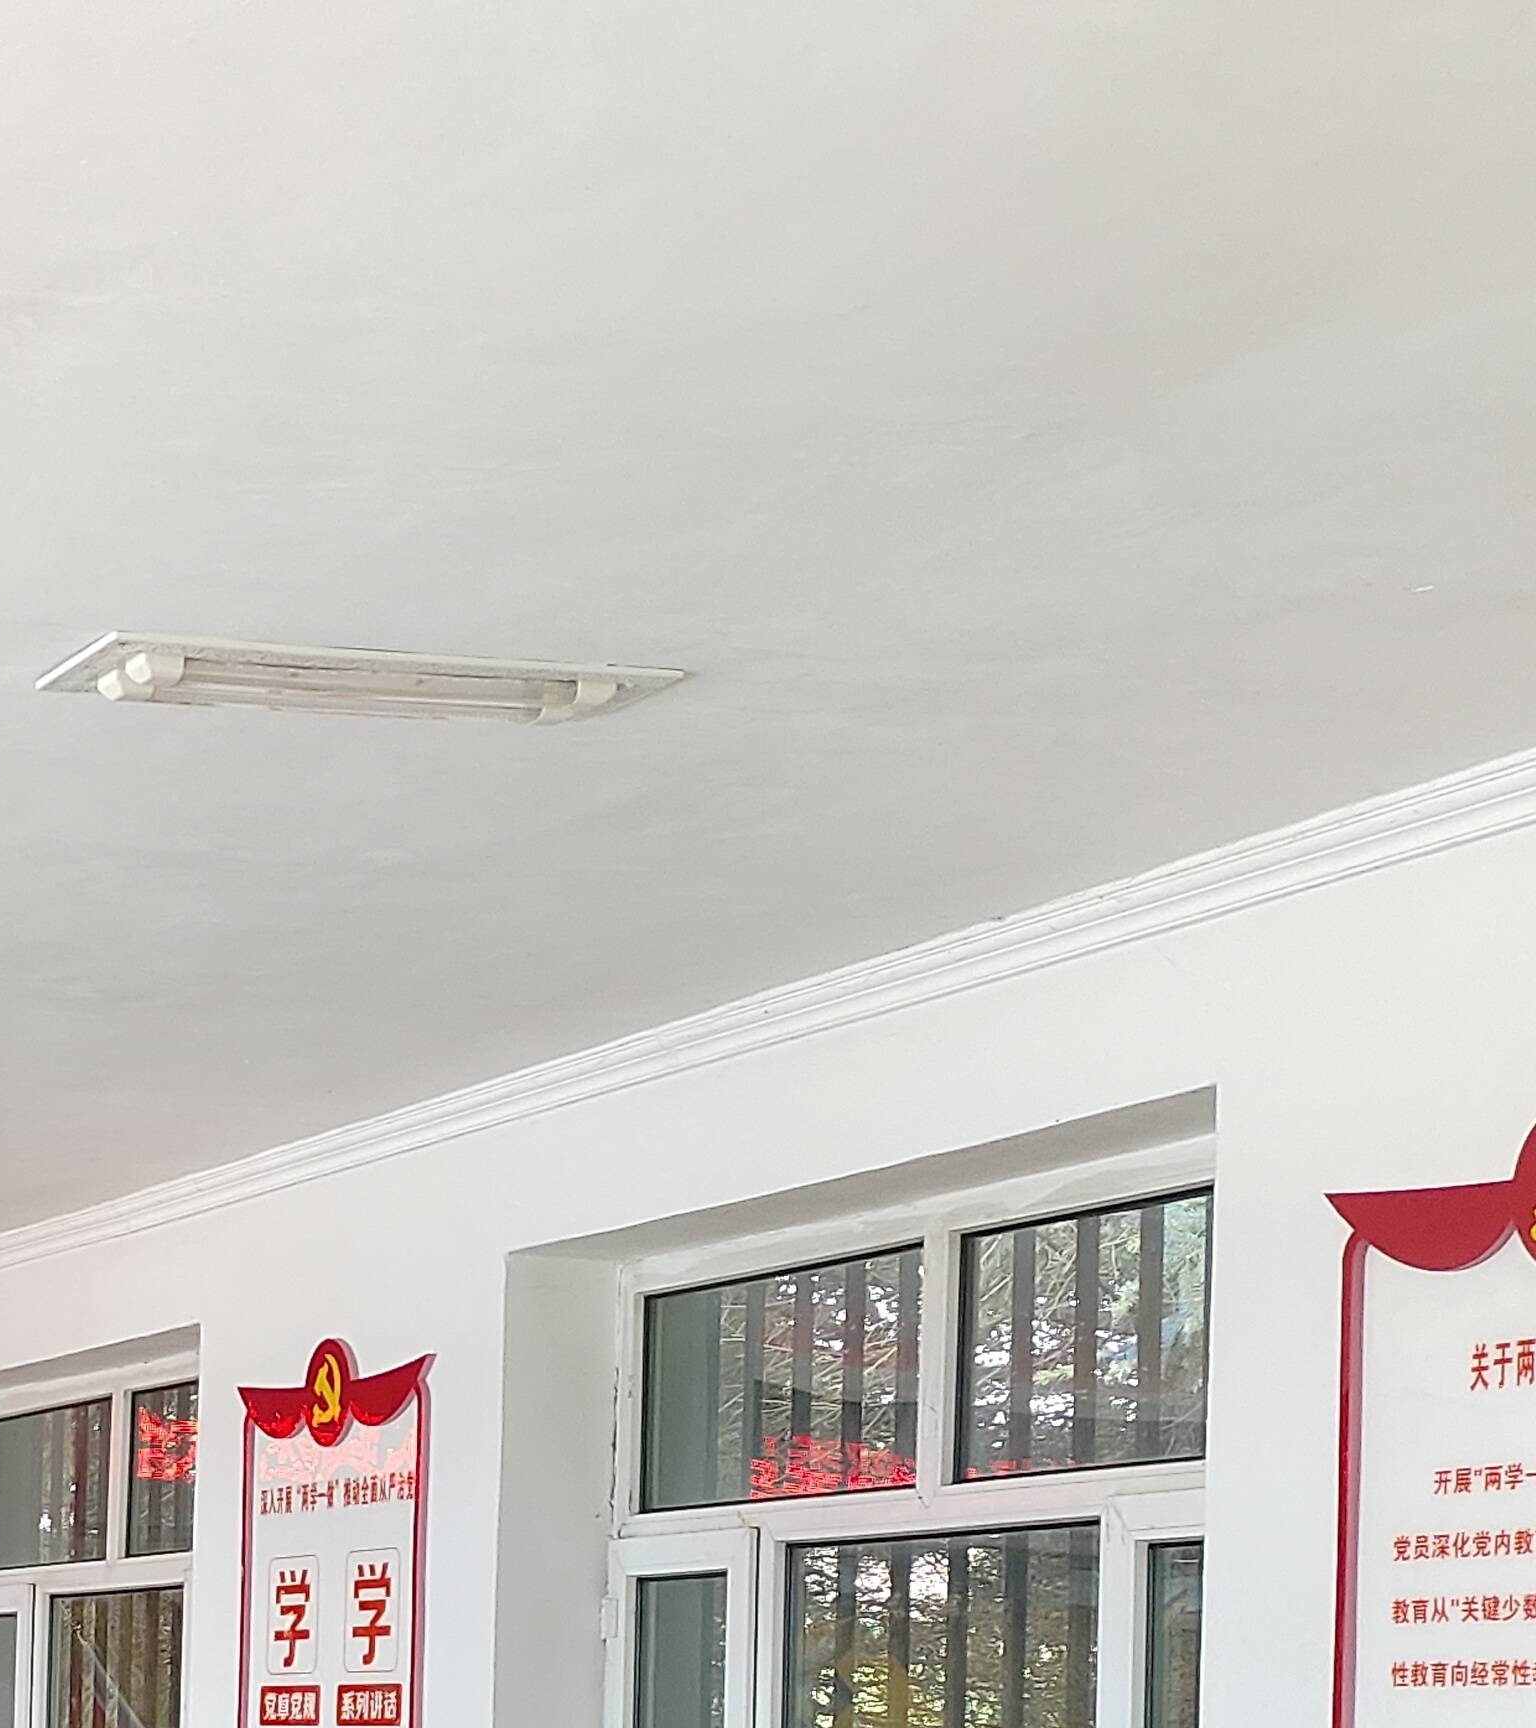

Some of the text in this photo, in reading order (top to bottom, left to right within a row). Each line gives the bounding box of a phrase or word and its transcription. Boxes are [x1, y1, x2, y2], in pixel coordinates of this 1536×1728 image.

[1470, 1339, 1536, 1391] 关于两
[1392, 1528, 1536, 1563] 党员深化党内教
[272, 1562, 391, 1667] 学 学
[1391, 1659, 1536, 1688] 性教育向经常性
[340, 1691, 398, 1721] 系列讲话
